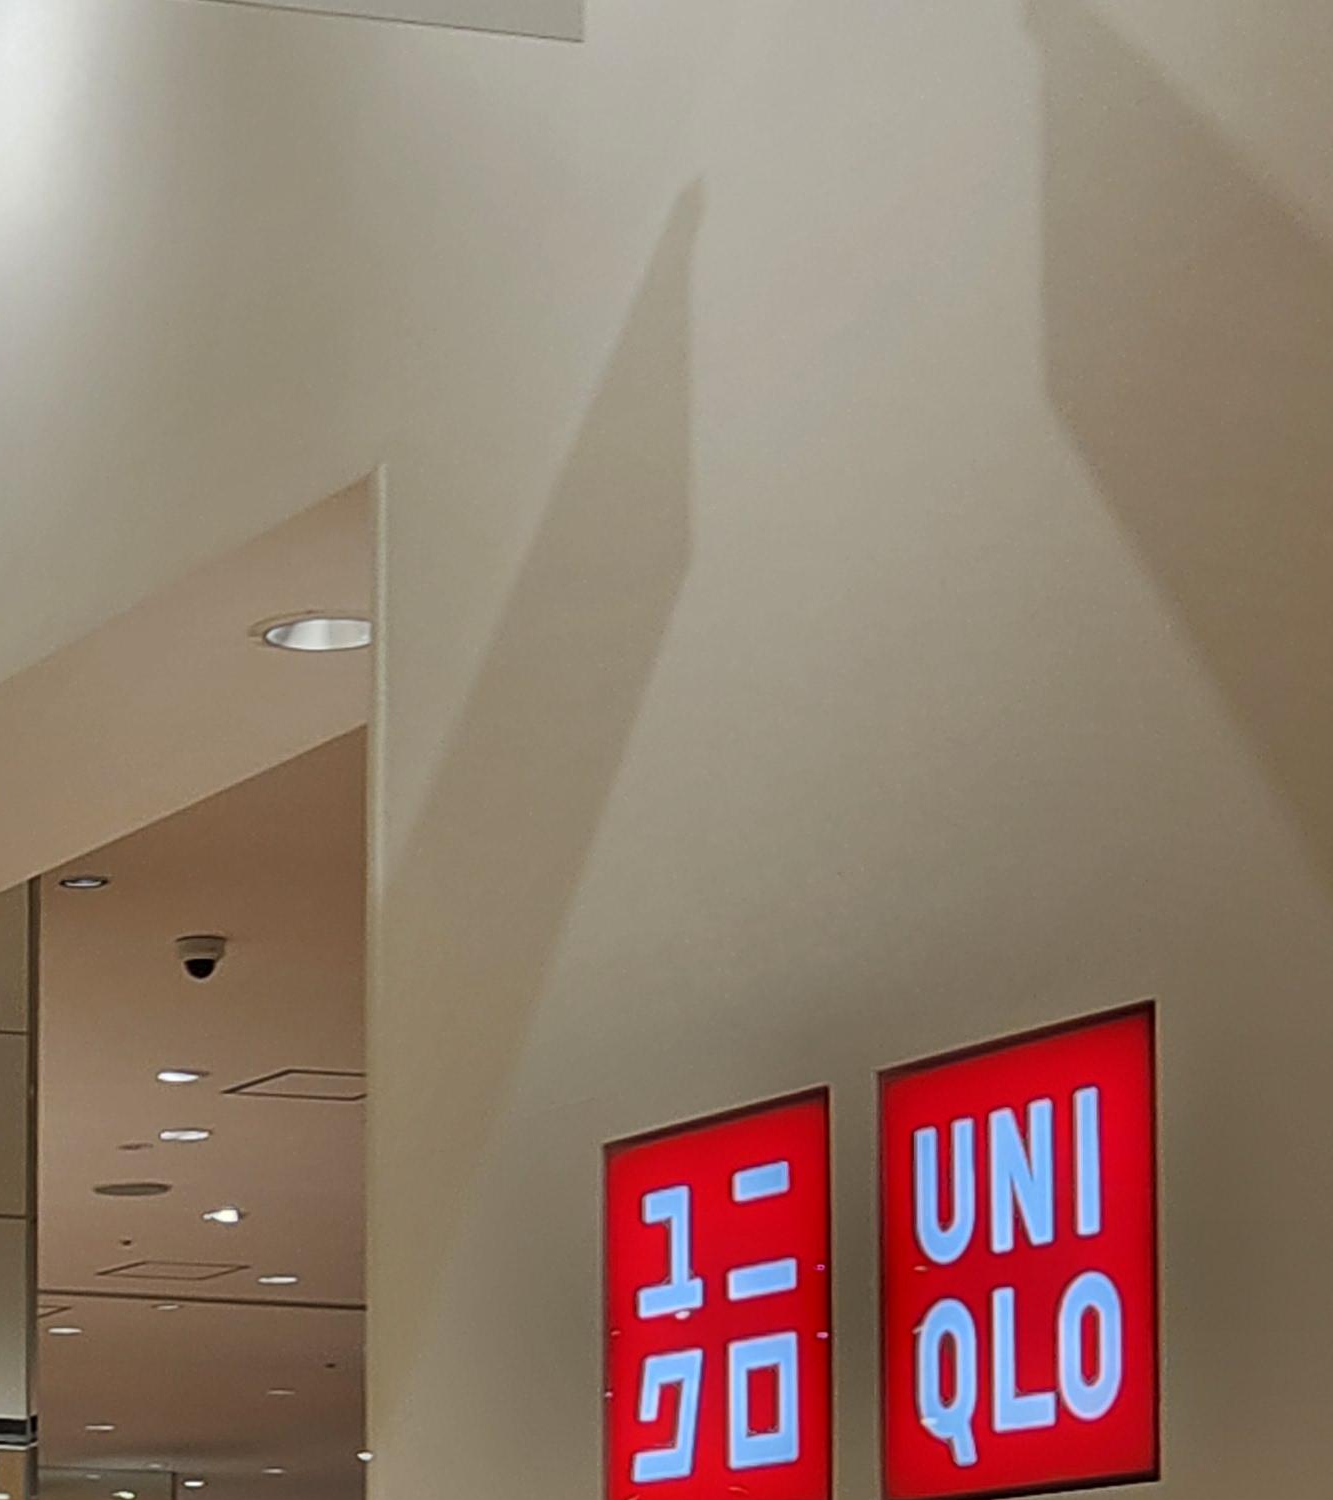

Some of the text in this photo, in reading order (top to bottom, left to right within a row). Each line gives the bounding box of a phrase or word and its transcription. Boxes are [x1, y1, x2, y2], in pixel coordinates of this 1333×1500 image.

[636, 1158, 799, 1320] ユニ
[911, 1085, 1103, 1265] UNI
[631, 1329, 799, 1484] クロ
[914, 1268, 1125, 1468] QLO
